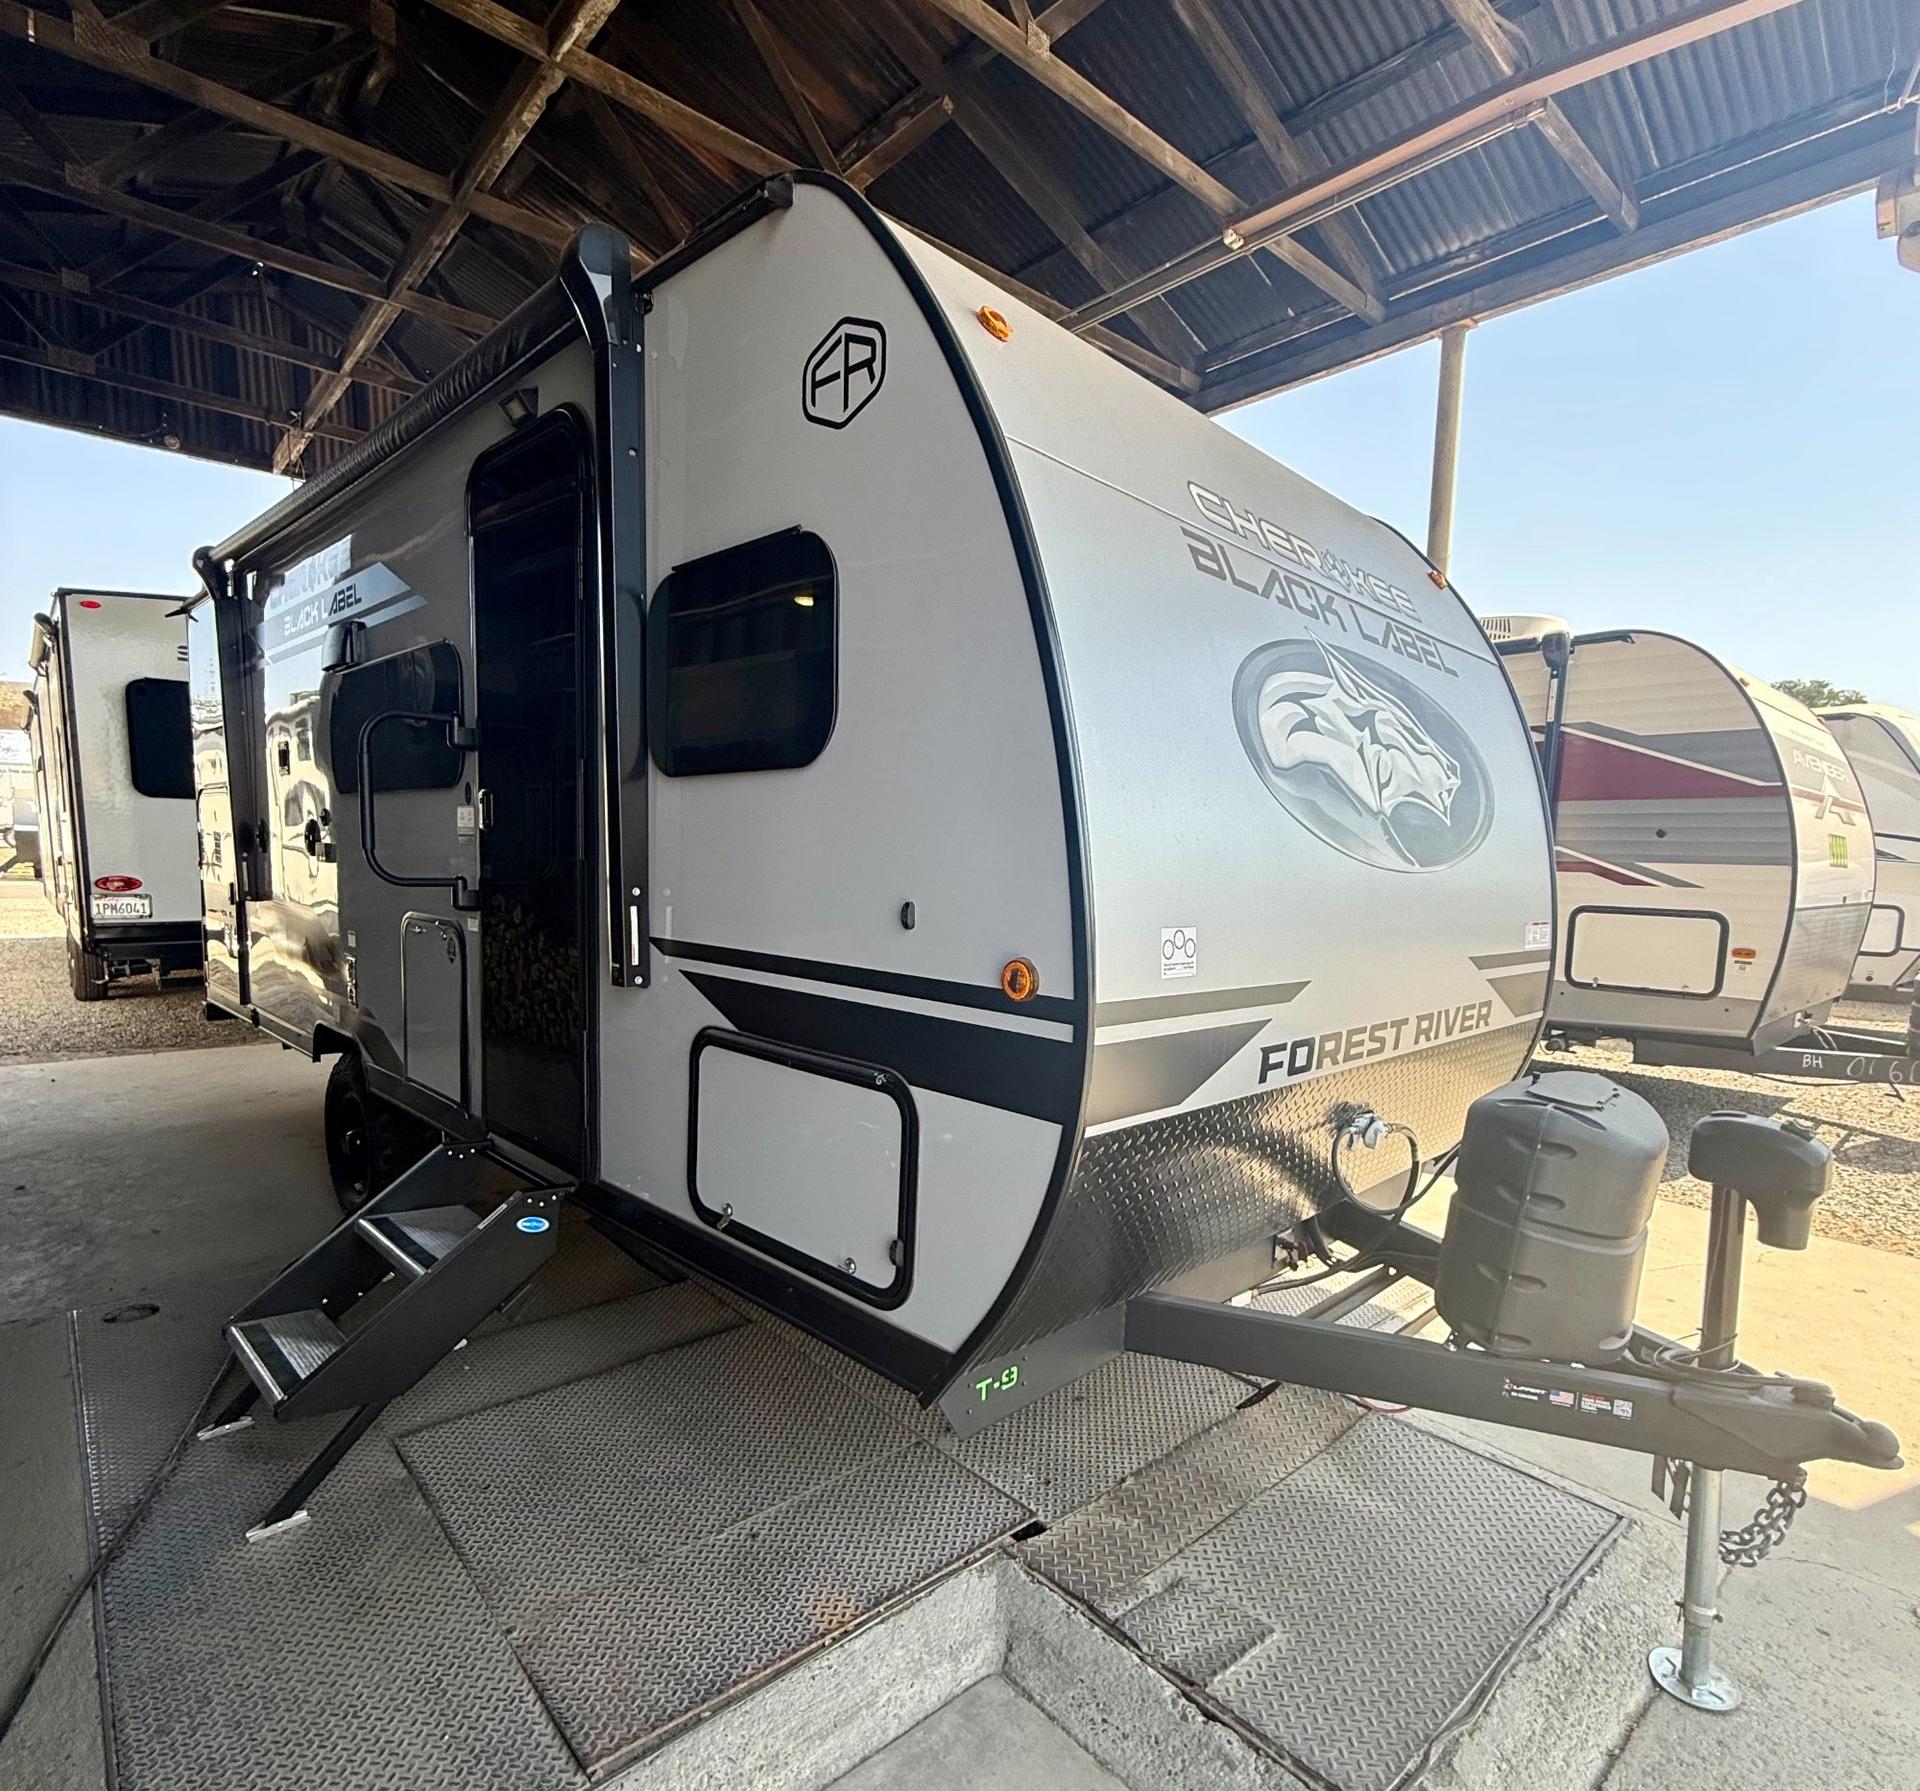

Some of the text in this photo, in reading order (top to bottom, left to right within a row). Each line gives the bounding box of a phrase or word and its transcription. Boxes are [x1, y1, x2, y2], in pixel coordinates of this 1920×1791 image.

[284, 583, 362, 636] BLACK LABEL
[1180, 526, 1459, 678] BLACK LABEL
[95, 902, 147, 915] 1PM6041
[1258, 1000, 1493, 1084] FOREST RIVER
[1802, 1054, 1823, 1069] BH
